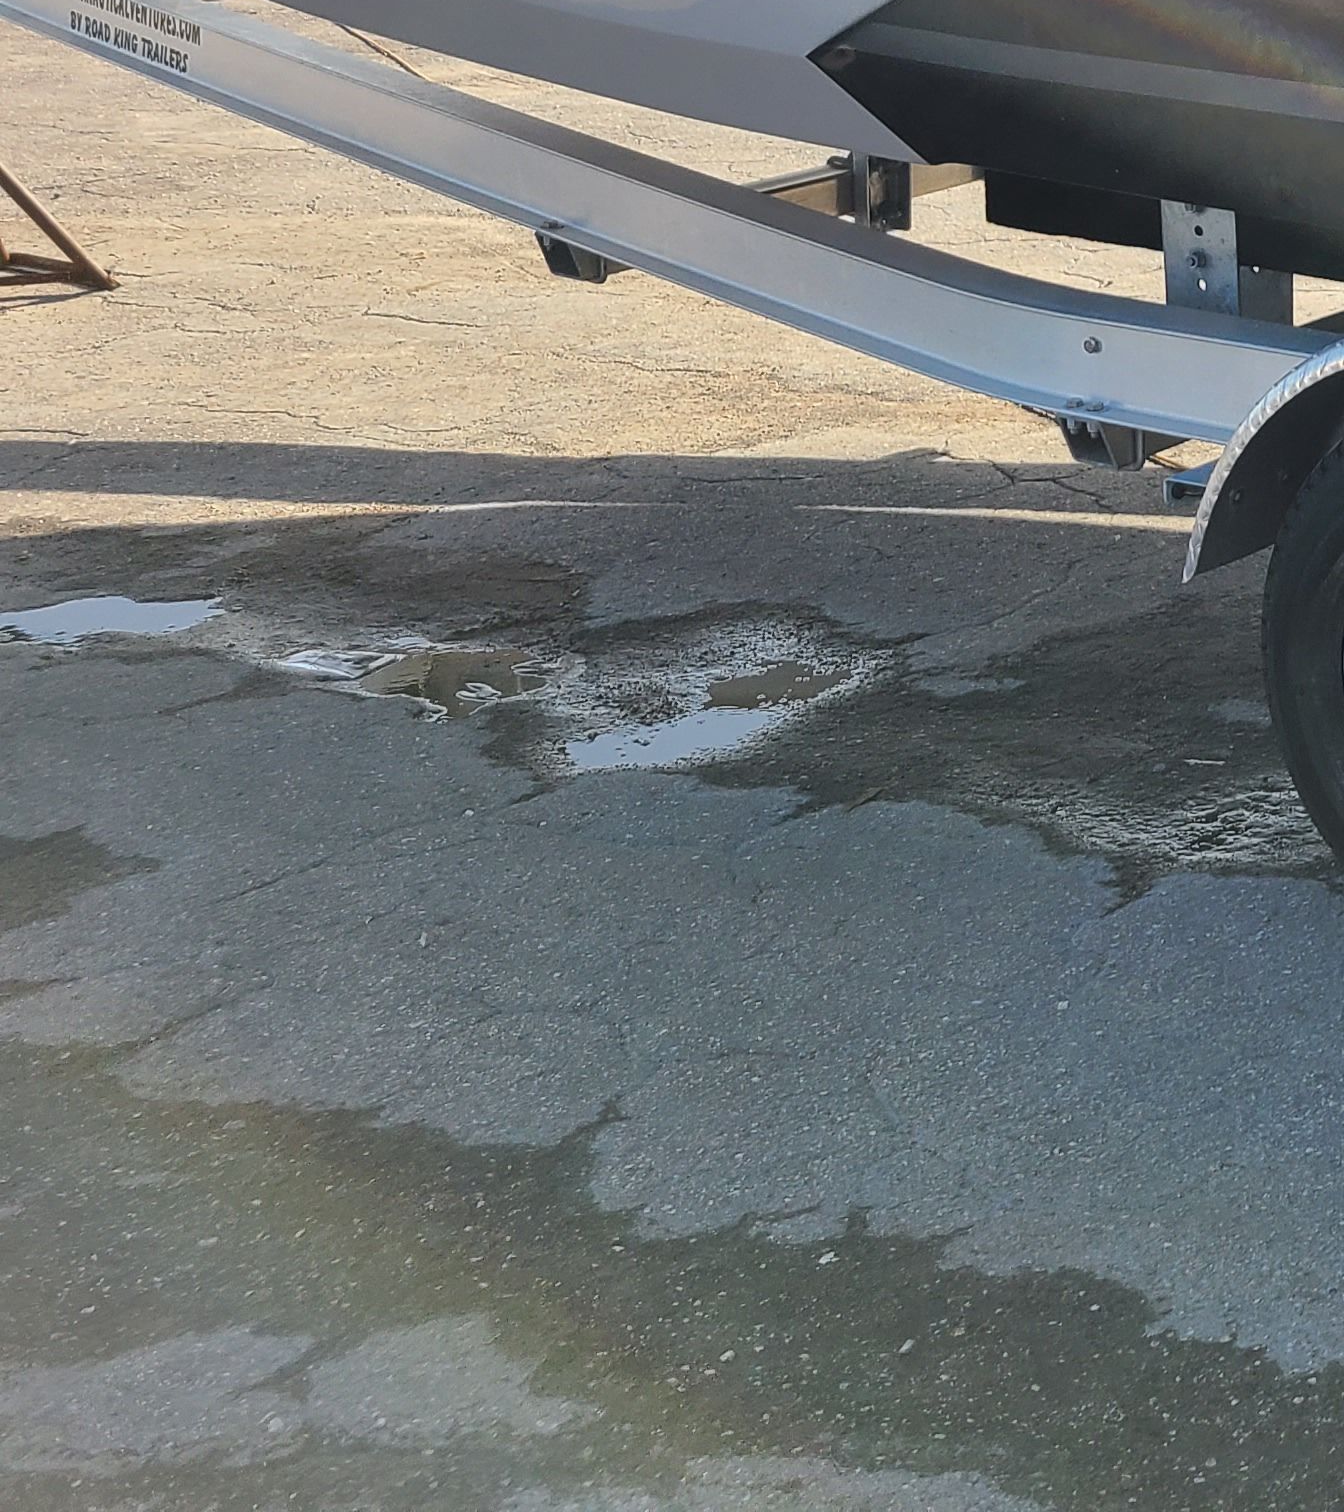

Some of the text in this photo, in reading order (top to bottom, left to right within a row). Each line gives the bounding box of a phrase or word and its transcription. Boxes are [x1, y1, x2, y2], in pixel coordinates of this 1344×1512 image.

[70, 10, 188, 73] BY ROAD KING TRAILERS
